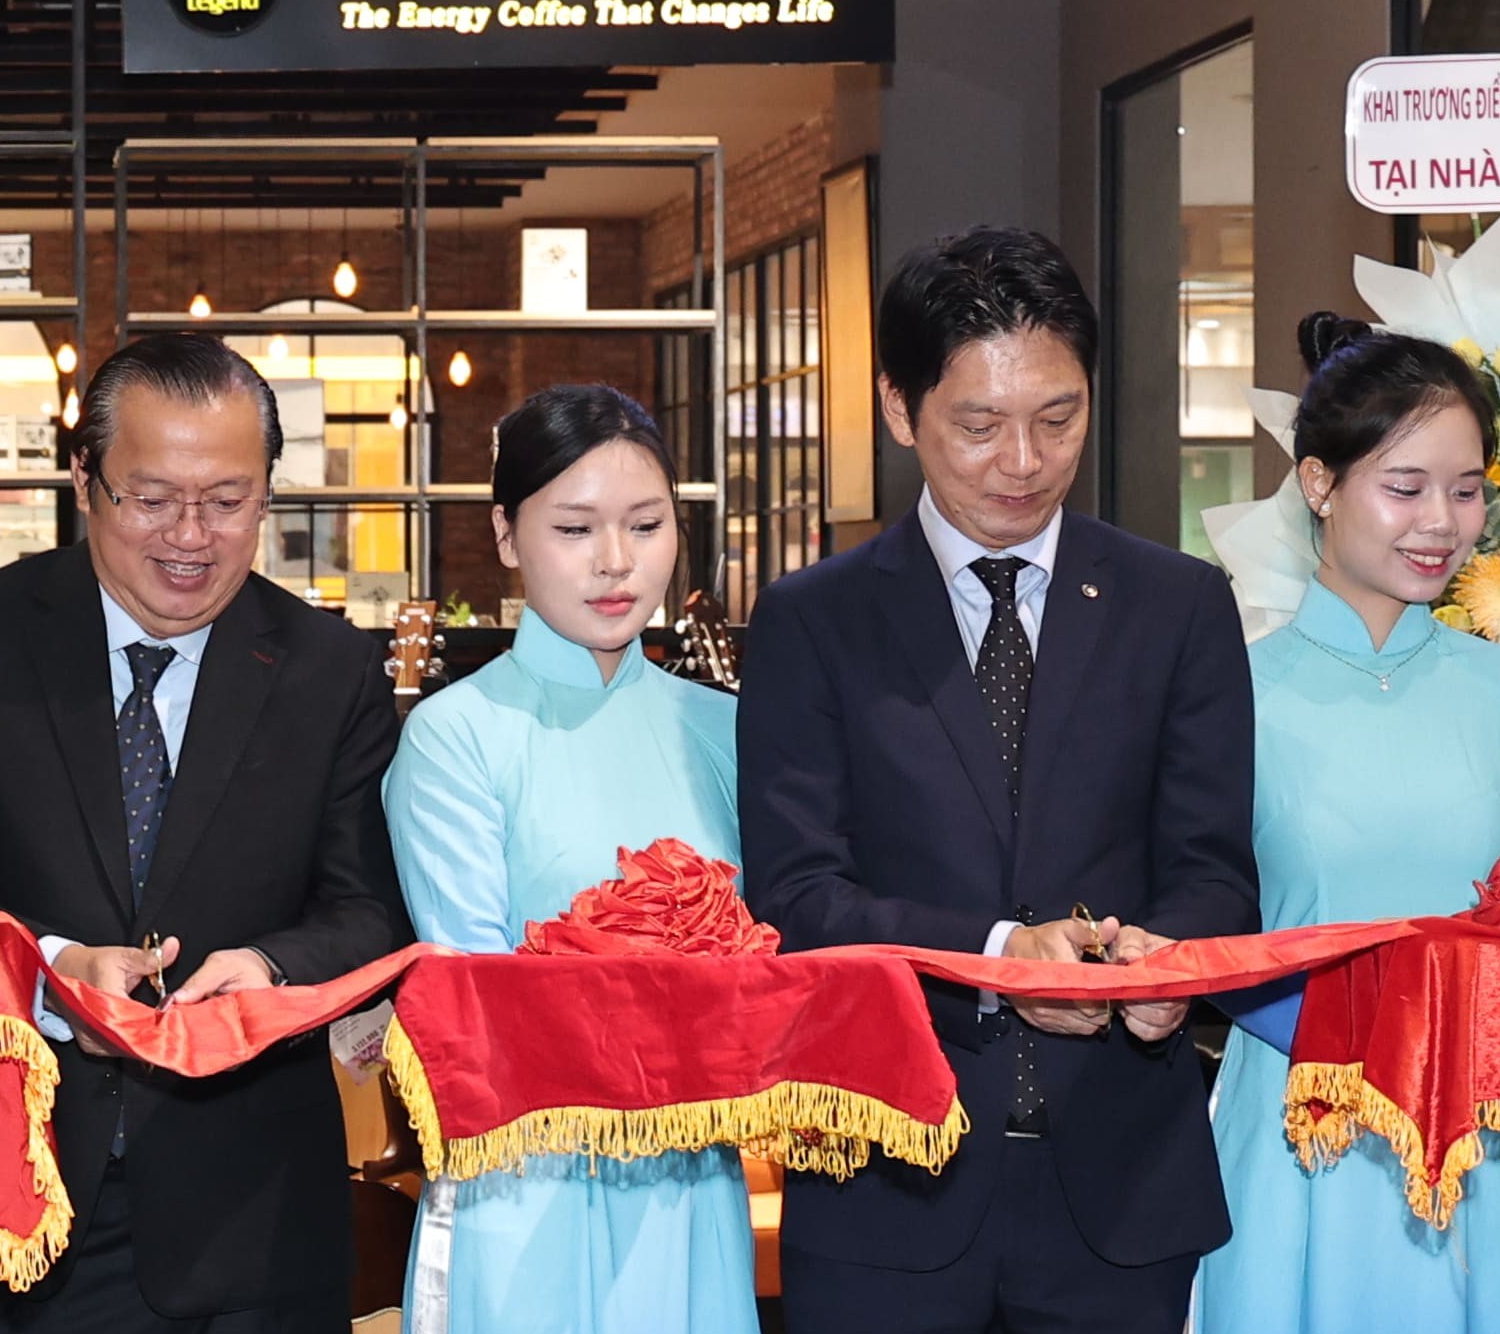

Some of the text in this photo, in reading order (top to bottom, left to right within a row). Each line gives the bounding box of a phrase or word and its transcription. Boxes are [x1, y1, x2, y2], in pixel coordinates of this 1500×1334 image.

[341, 1, 390, 29] The
[397, 1, 490, 34] Energy
[1363, 89, 1399, 123] KHAI
[1403, 84, 1471, 120] TRƯƠNG
[1368, 157, 1418, 198] TẠI
[1429, 148, 1500, 189] NHÀ
